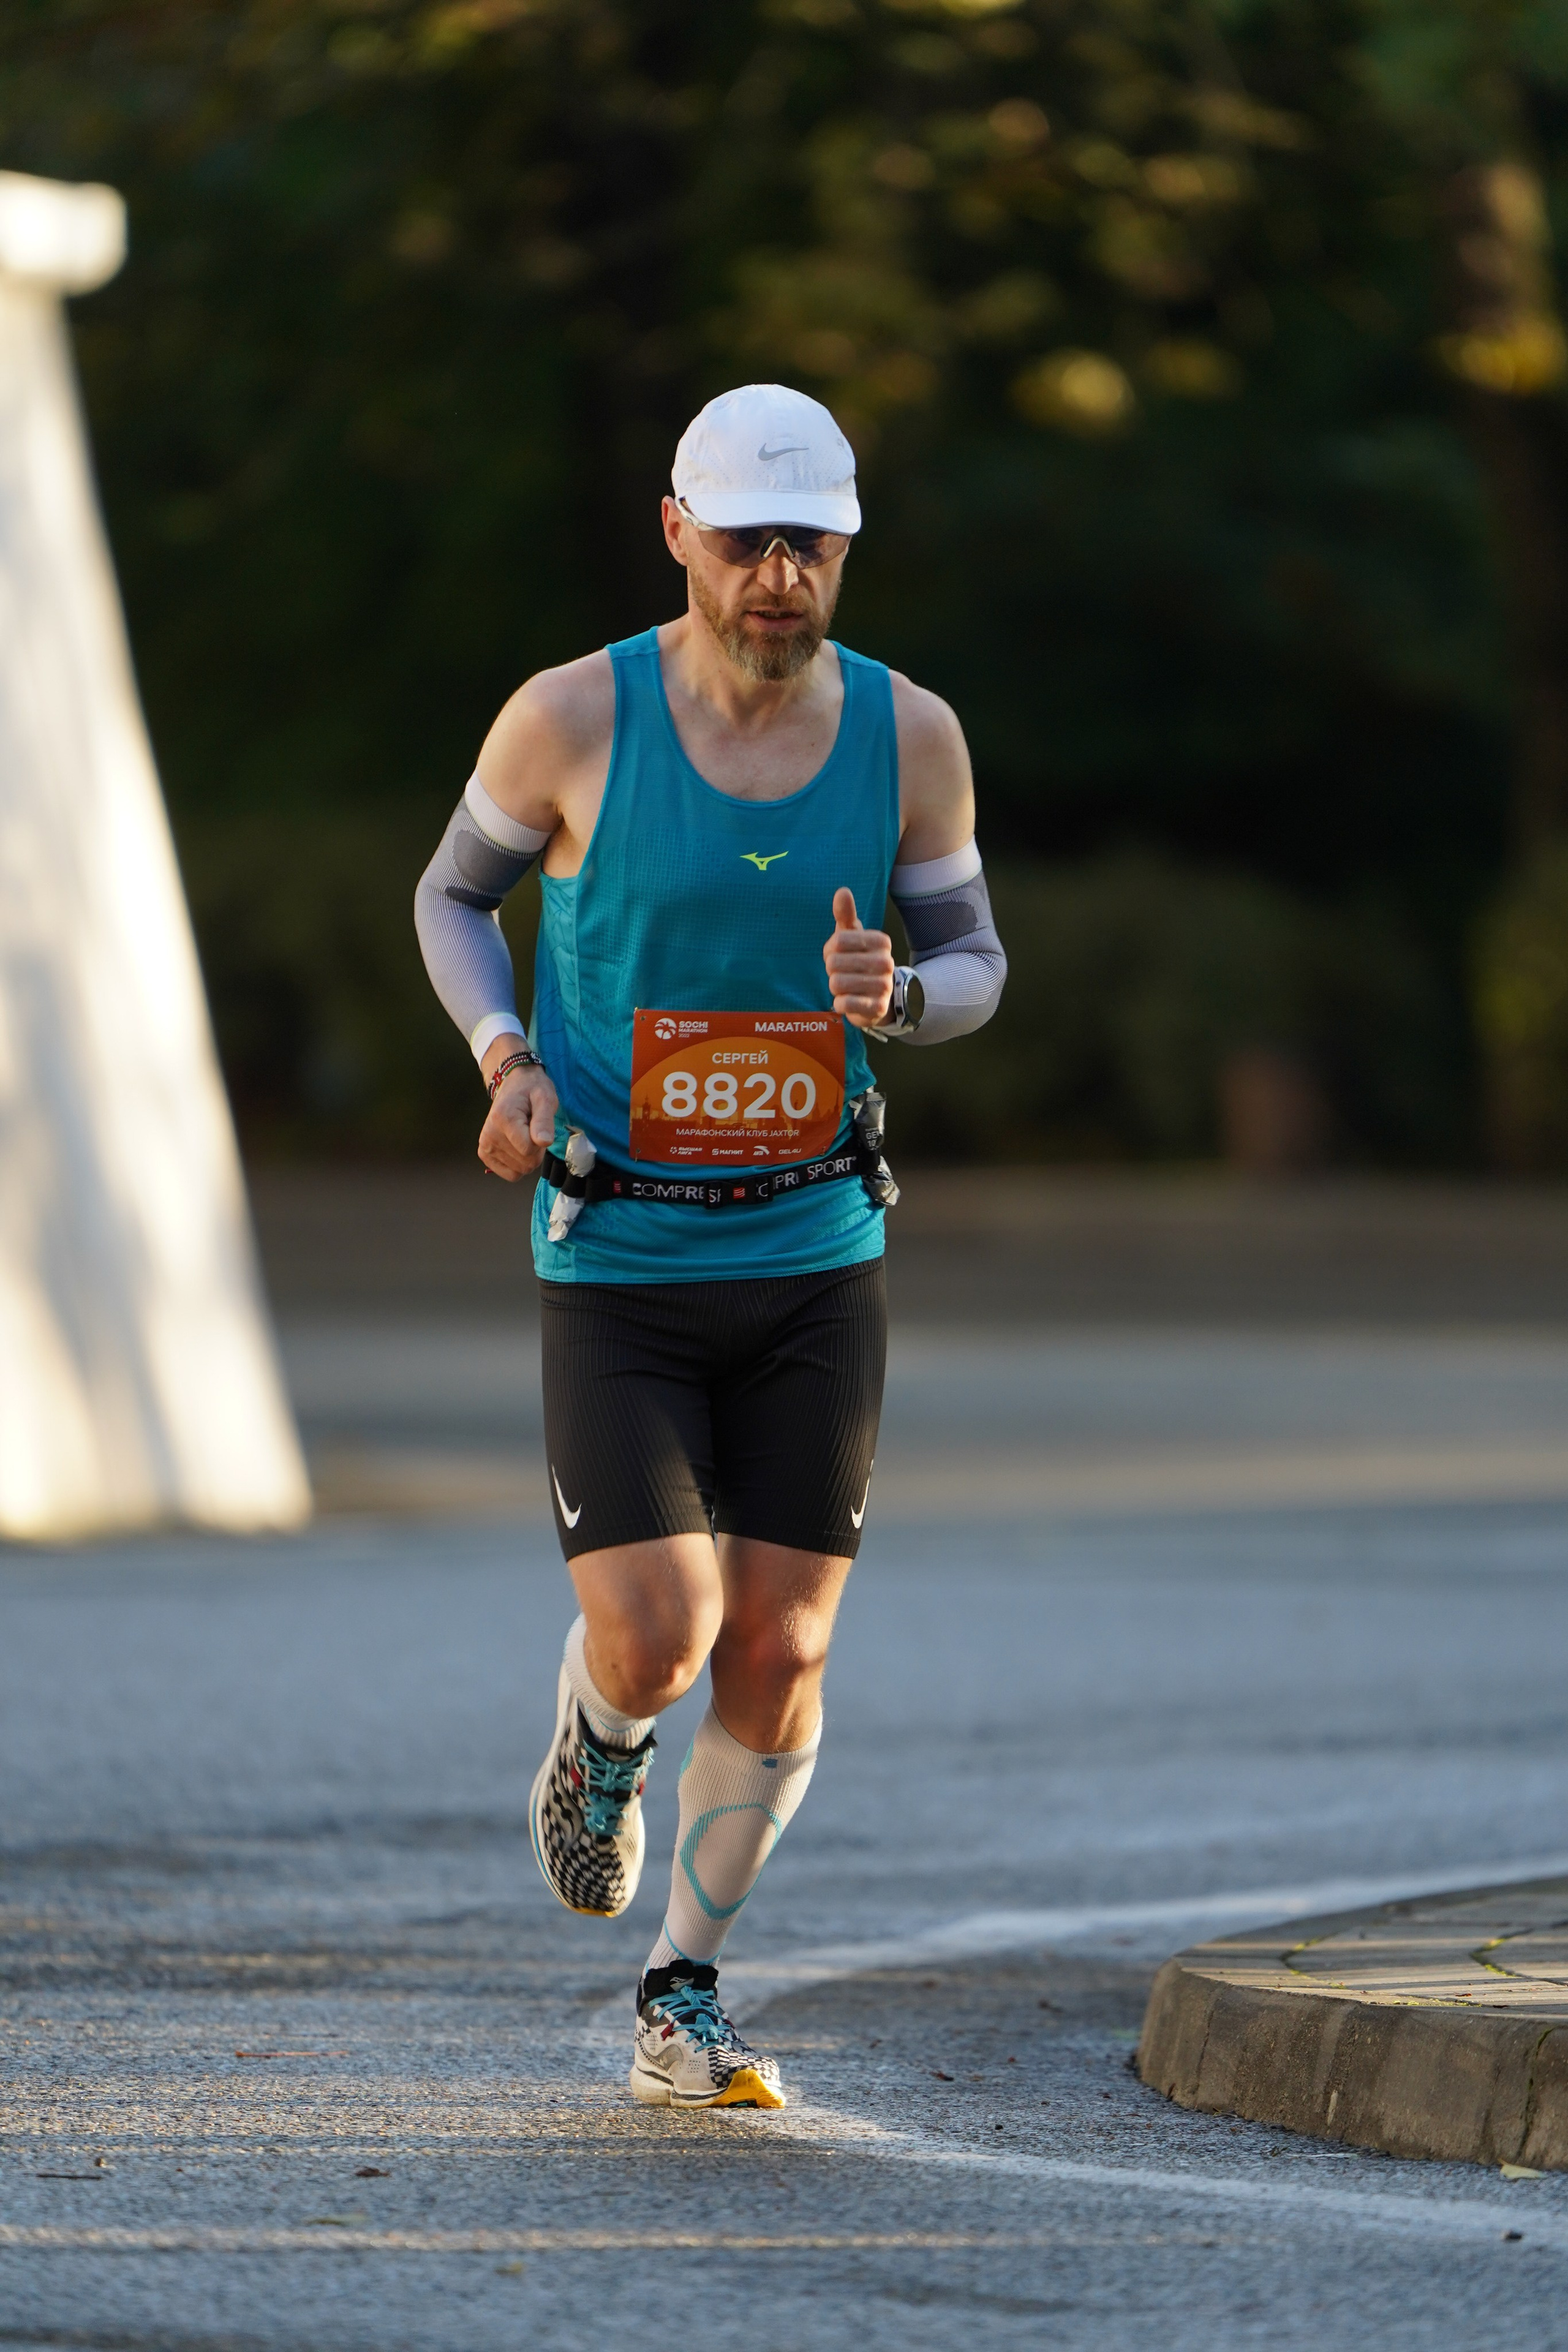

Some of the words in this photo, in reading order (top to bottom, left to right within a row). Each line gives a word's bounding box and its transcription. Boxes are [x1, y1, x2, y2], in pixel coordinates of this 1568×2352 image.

[755, 1022, 827, 1032] MARATHON
[712, 1050, 769, 1064] СЕРГЕЙ
[662, 1072, 816, 1119] 8820
[676, 1128, 745, 1137] МАРАФОНСКИЙ
